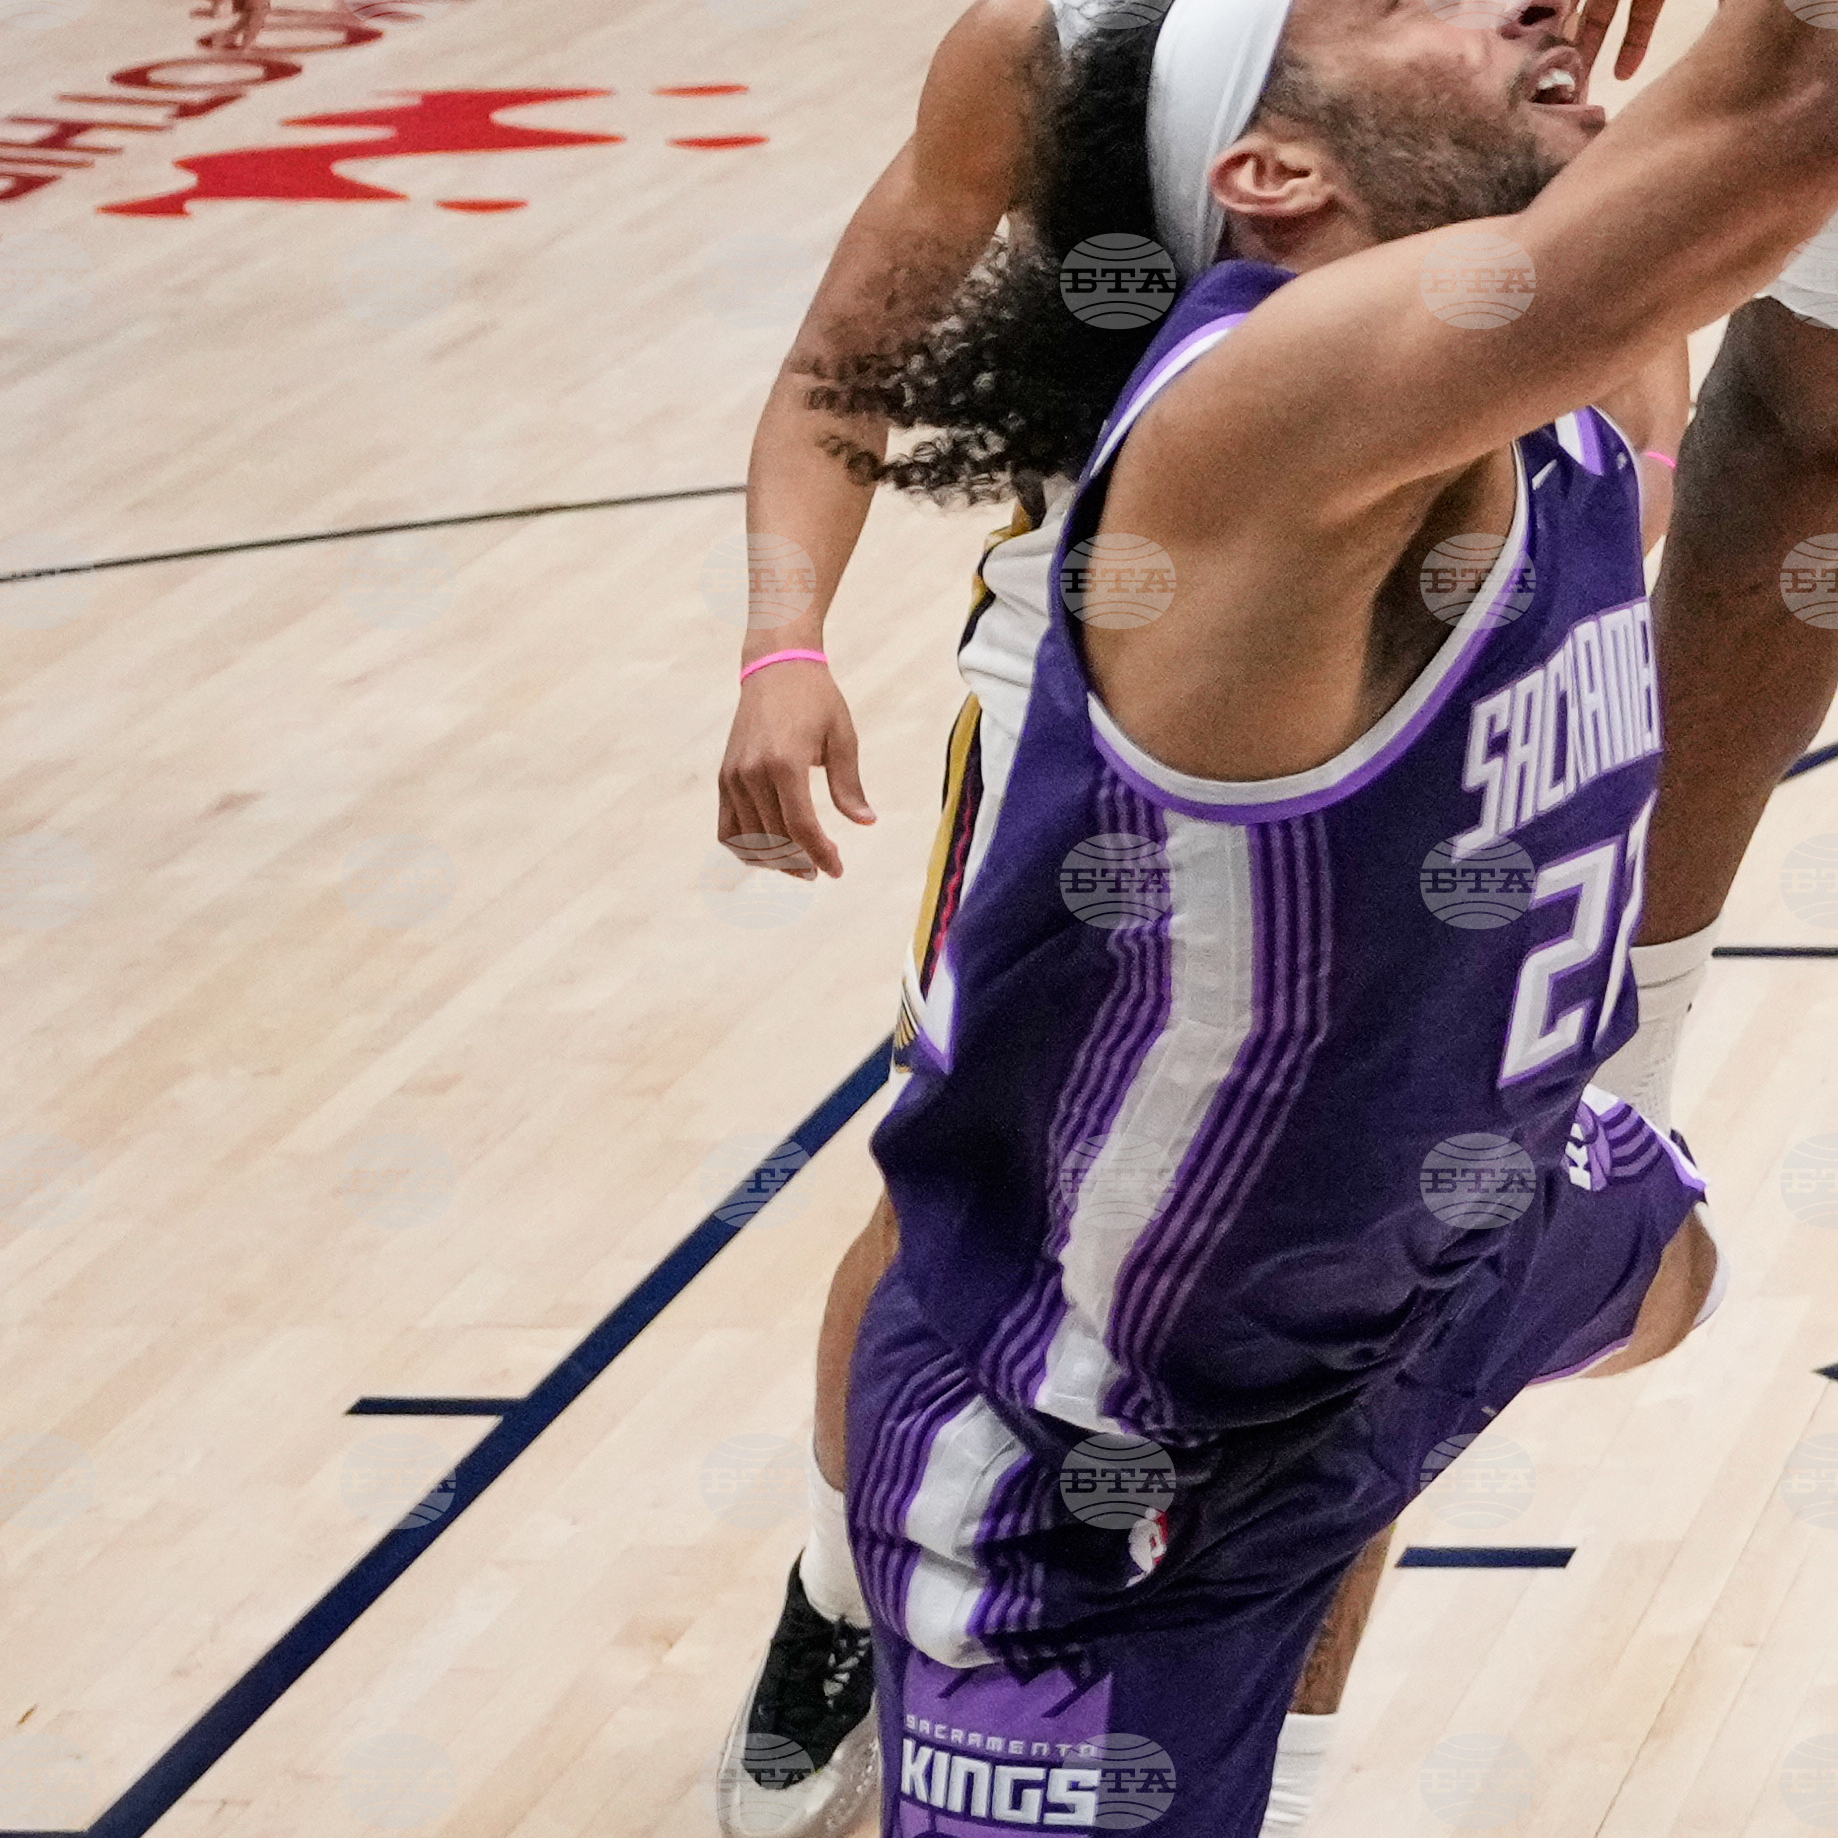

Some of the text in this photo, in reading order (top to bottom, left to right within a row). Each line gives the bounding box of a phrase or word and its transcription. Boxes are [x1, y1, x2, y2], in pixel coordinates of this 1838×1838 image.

[1497, 788, 1659, 1090] 21
[904, 1713, 1100, 1758] SACRAMENTO
[900, 1736, 1102, 1827] KINGS
